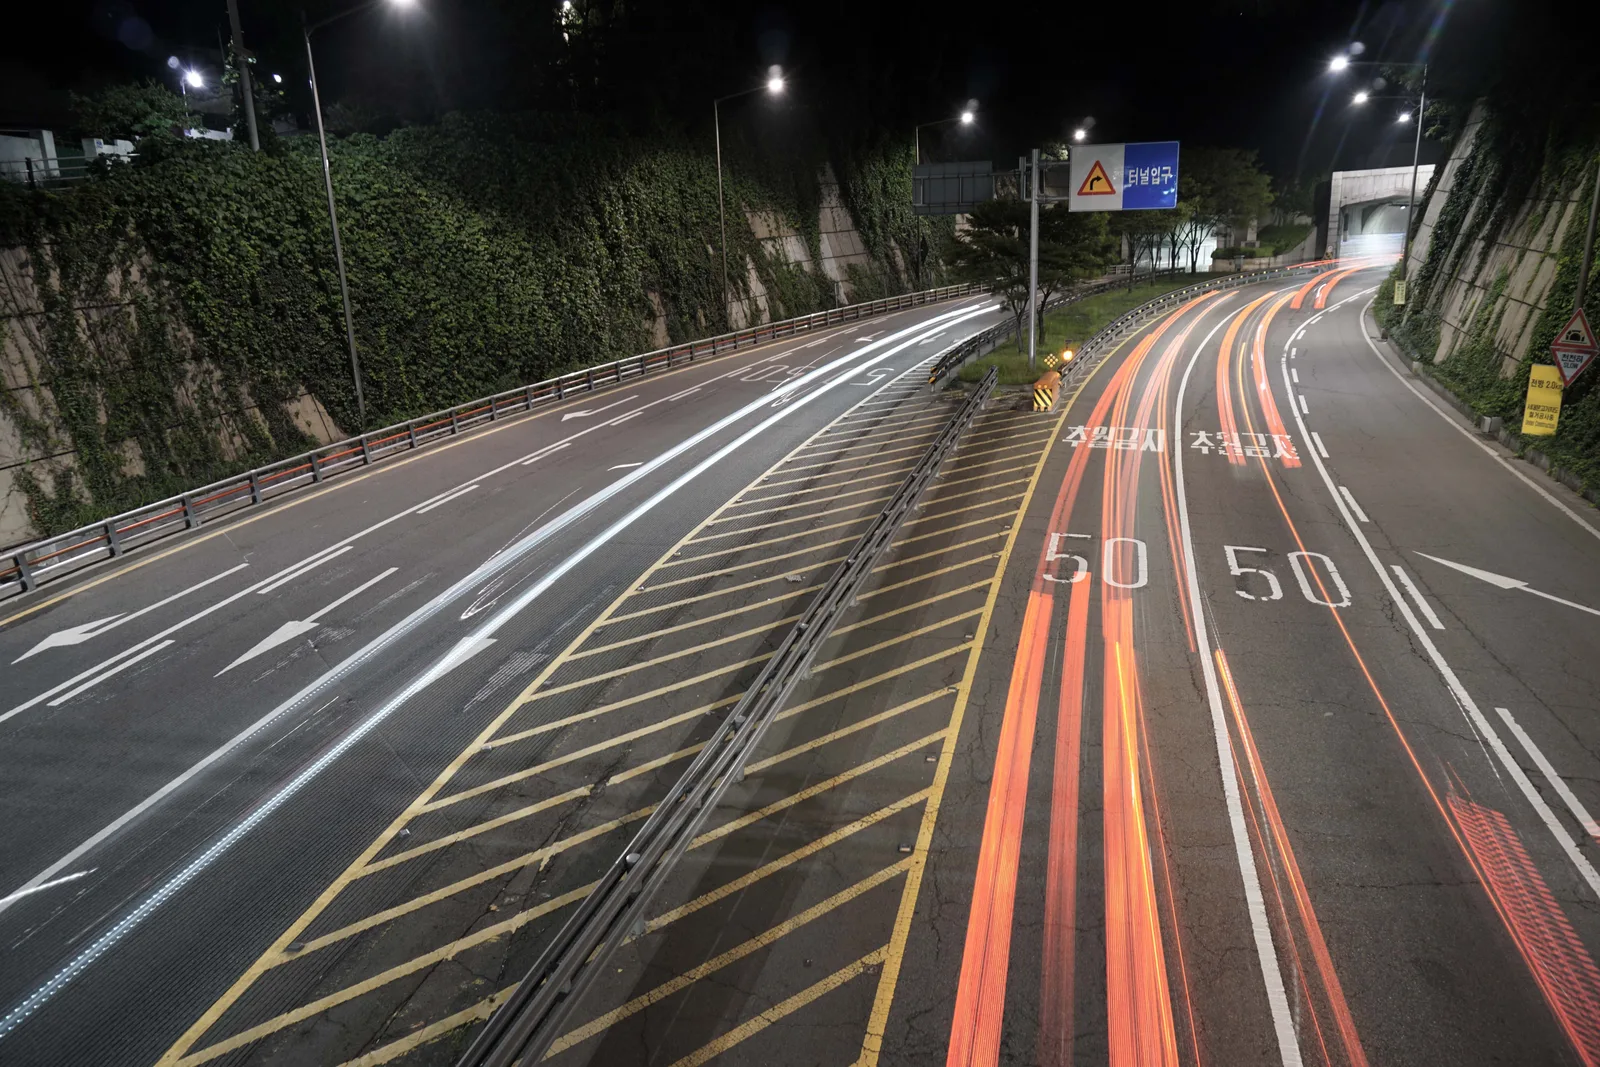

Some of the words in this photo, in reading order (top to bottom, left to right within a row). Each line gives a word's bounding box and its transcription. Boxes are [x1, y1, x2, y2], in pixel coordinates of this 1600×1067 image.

[1128, 166, 1173, 186] 터널입구
[1561, 354, 1583, 363] 천천히
[1531, 379, 1544, 388] 전방
[1062, 425, 1165, 453] 추월금지
[1042, 532, 1148, 589] 50
[1223, 544, 1352, 608] 50
